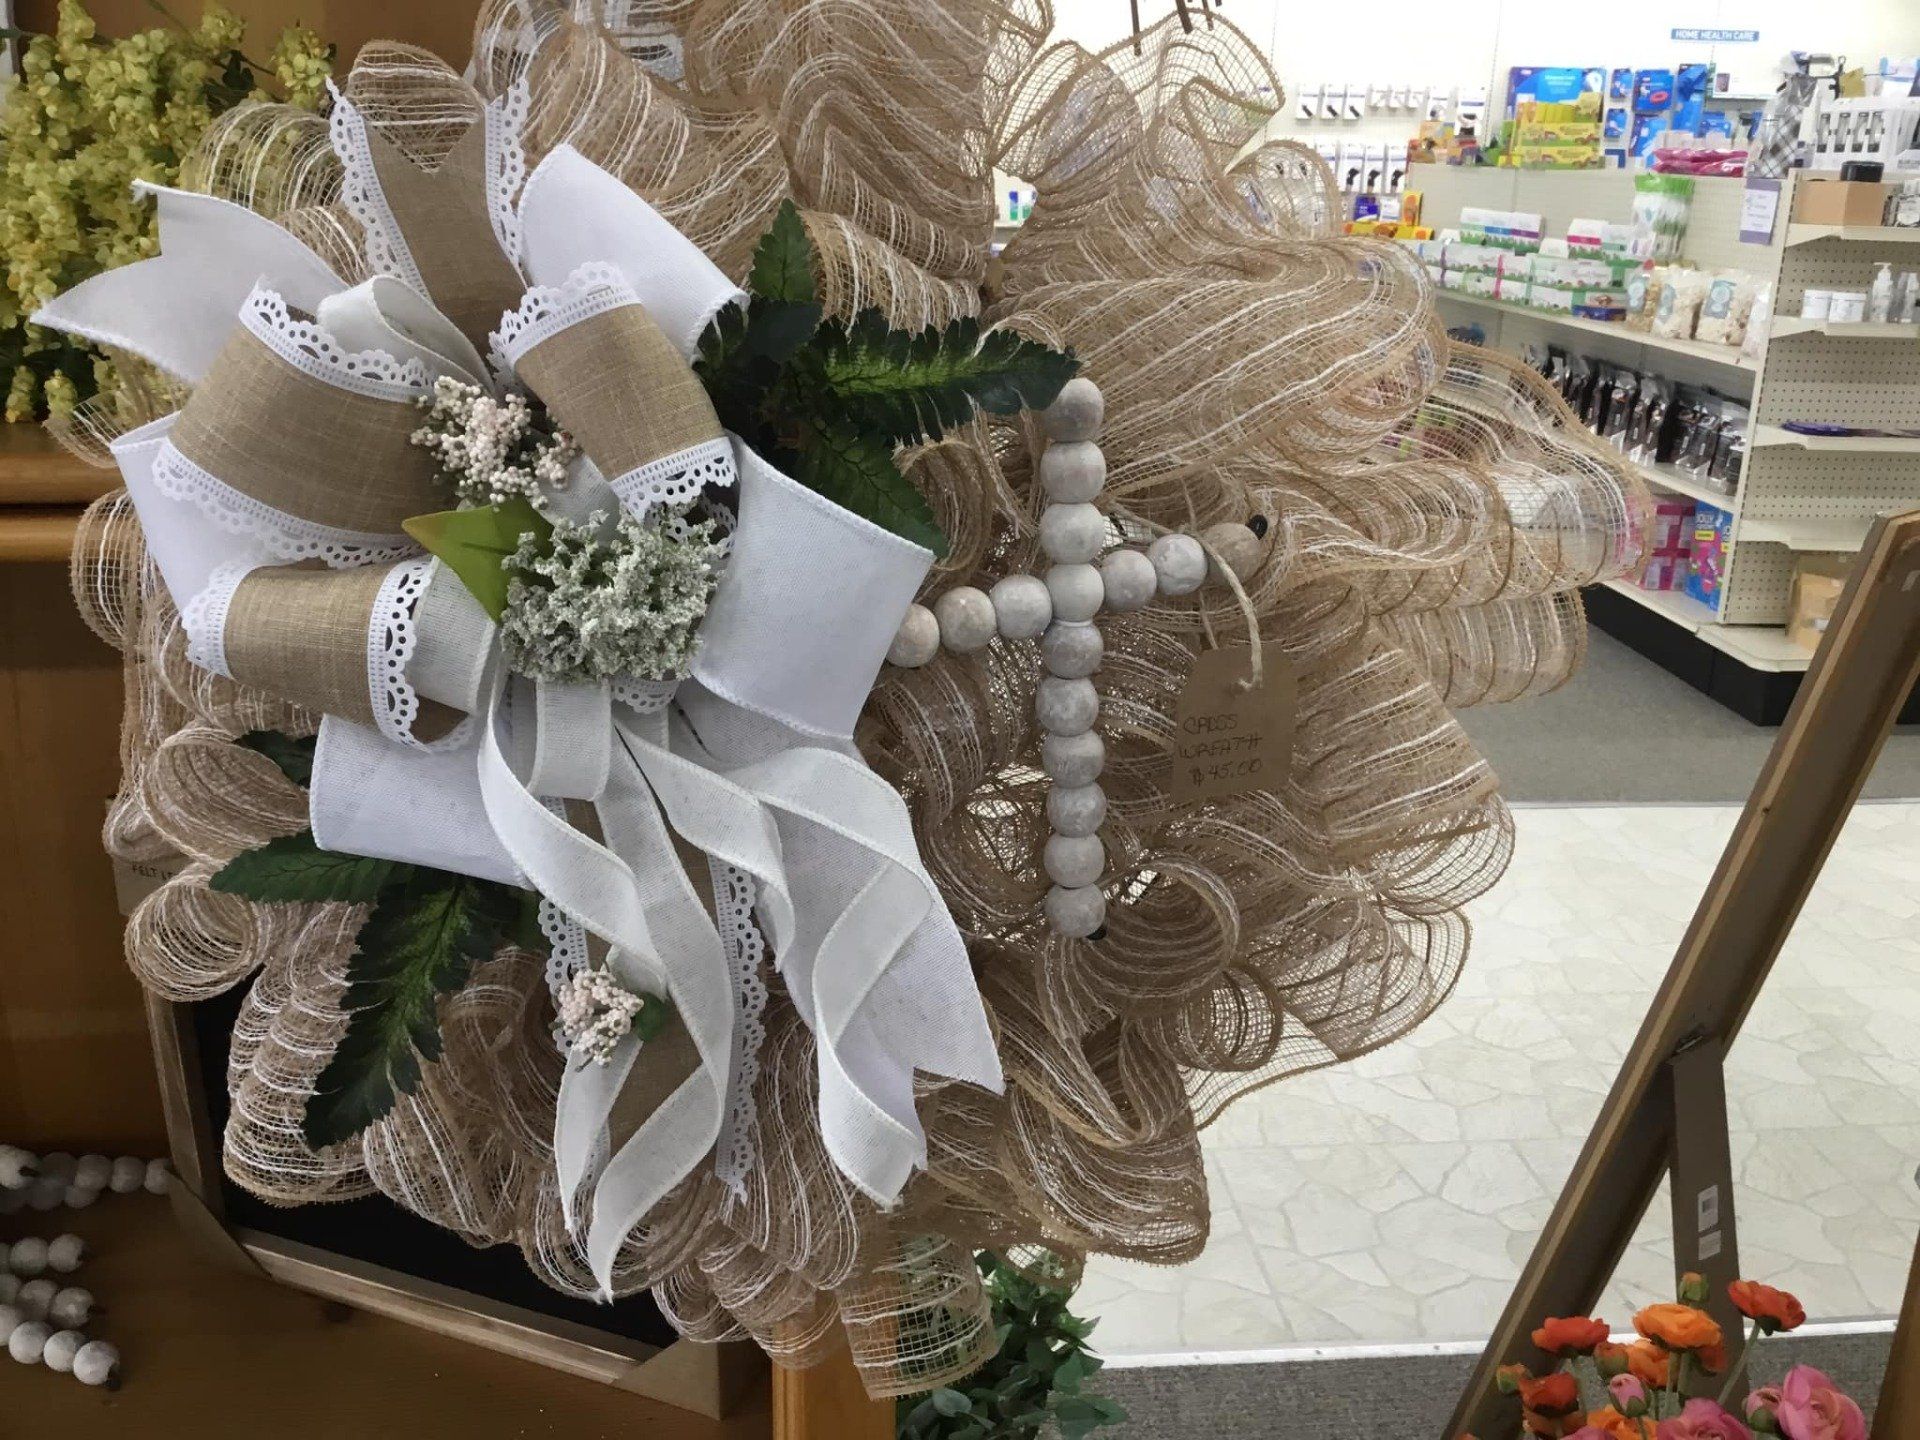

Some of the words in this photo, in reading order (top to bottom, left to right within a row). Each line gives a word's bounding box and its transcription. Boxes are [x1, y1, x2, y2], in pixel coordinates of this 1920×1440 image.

[1675, 29, 1699, 39] HOME
[1700, 30, 1732, 40] HEALTH
[1733, 31, 1755, 41] CARE
[1178, 732, 1263, 760] WREATH
[132, 864, 157, 877] FELT
